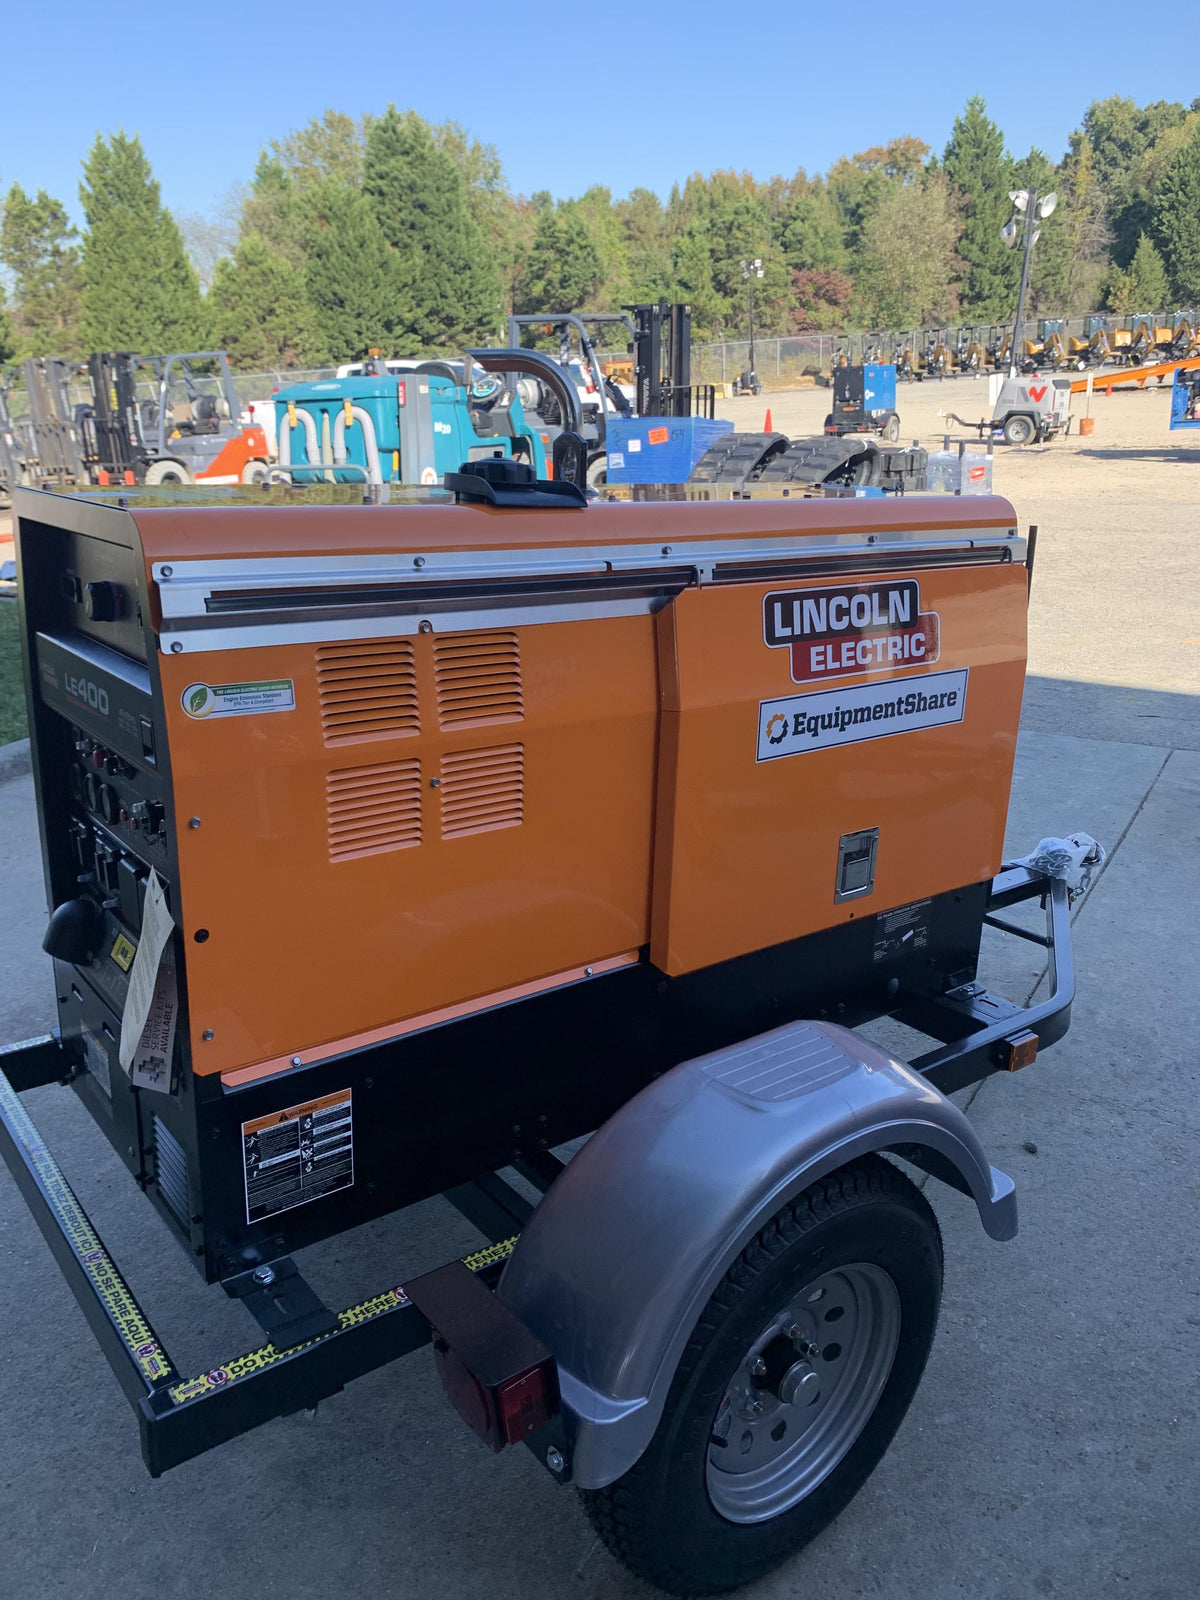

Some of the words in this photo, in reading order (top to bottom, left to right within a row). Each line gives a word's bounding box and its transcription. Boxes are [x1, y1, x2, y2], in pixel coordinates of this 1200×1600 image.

[773, 589, 911, 638] LINCOLN
[810, 632, 926, 673] ELECTRIC
[64, 672, 109, 716] LE400
[791, 690, 958, 738] EquipmentShare
[151, 1011, 163, 1051] SERVICE
[159, 1002, 174, 1054] AVAILABLE
[288, 1104, 319, 1118] WARNING
[42, 1164, 55, 1179] PAS
[50, 1178, 68, 1204] TENEZ
[62, 1204, 87, 1238] DEBOUT
[80, 1238, 94, 1251] ICI
[93, 1261, 108, 1278] NO
[101, 1277, 116, 1291] SE
[108, 1291, 131, 1318] PARE
[230, 1359, 257, 1375] DO
[259, 1348, 281, 1361] NO
[352, 1296, 396, 1319] HERE
